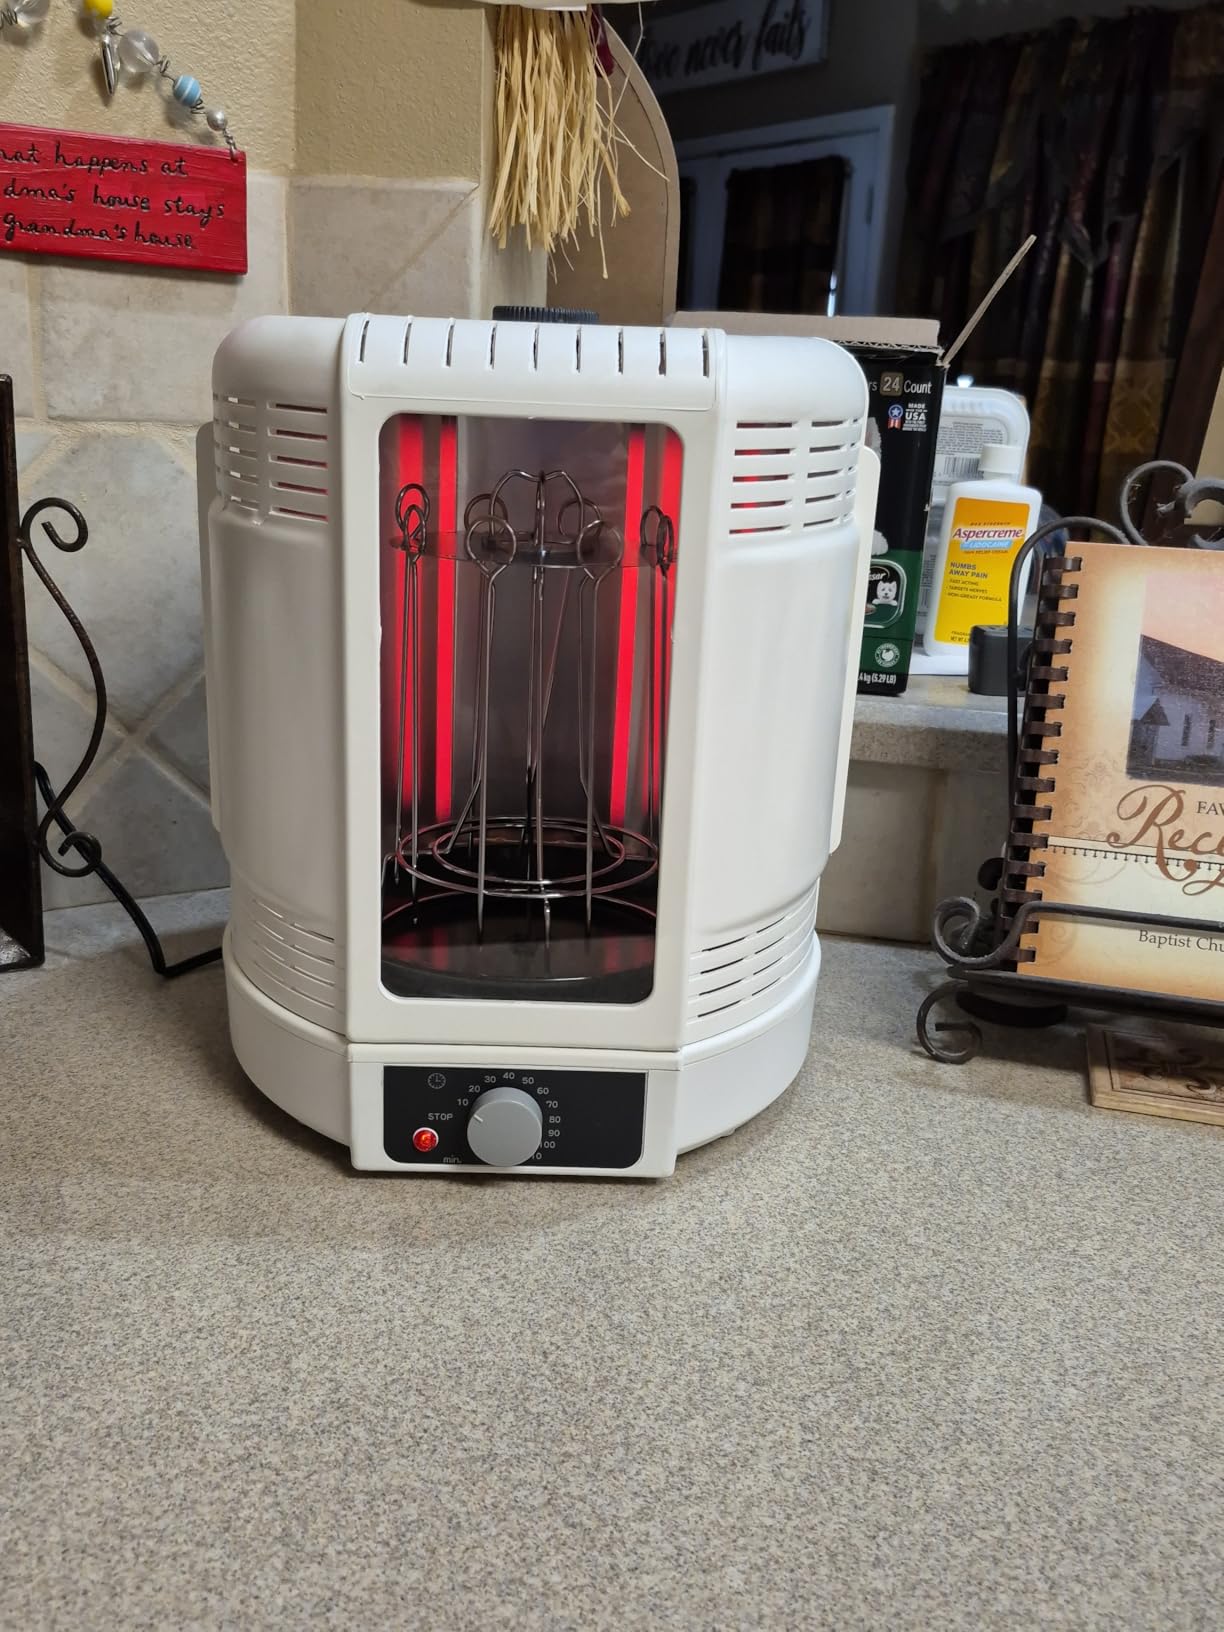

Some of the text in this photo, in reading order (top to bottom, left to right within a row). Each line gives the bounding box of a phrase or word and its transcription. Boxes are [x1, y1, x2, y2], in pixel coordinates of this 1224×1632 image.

[55, 141, 148, 175] happens
[161, 157, 188, 176] at
[3, 178, 225, 227] dma's house stays
[3, 212, 195, 249] grandma's house
[883, 376, 901, 392] 24
[904, 380, 933, 394] Count
[905, 412, 927, 420] USA
[953, 528, 1023, 542] Aspercreme
[950, 562, 977, 570] NUMBS
[1139, 929, 1191, 949] Baptist
[484, 1075, 497, 1083] 30
[502, 1072, 515, 1080] 40
[468, 1085, 481, 1093] 20
[537, 1087, 550, 1095] 60
[457, 1098, 469, 1107] 10
[545, 1100, 559, 1109] 70
[427, 1113, 453, 1121] STOP
[548, 1129, 560, 1137] 90
